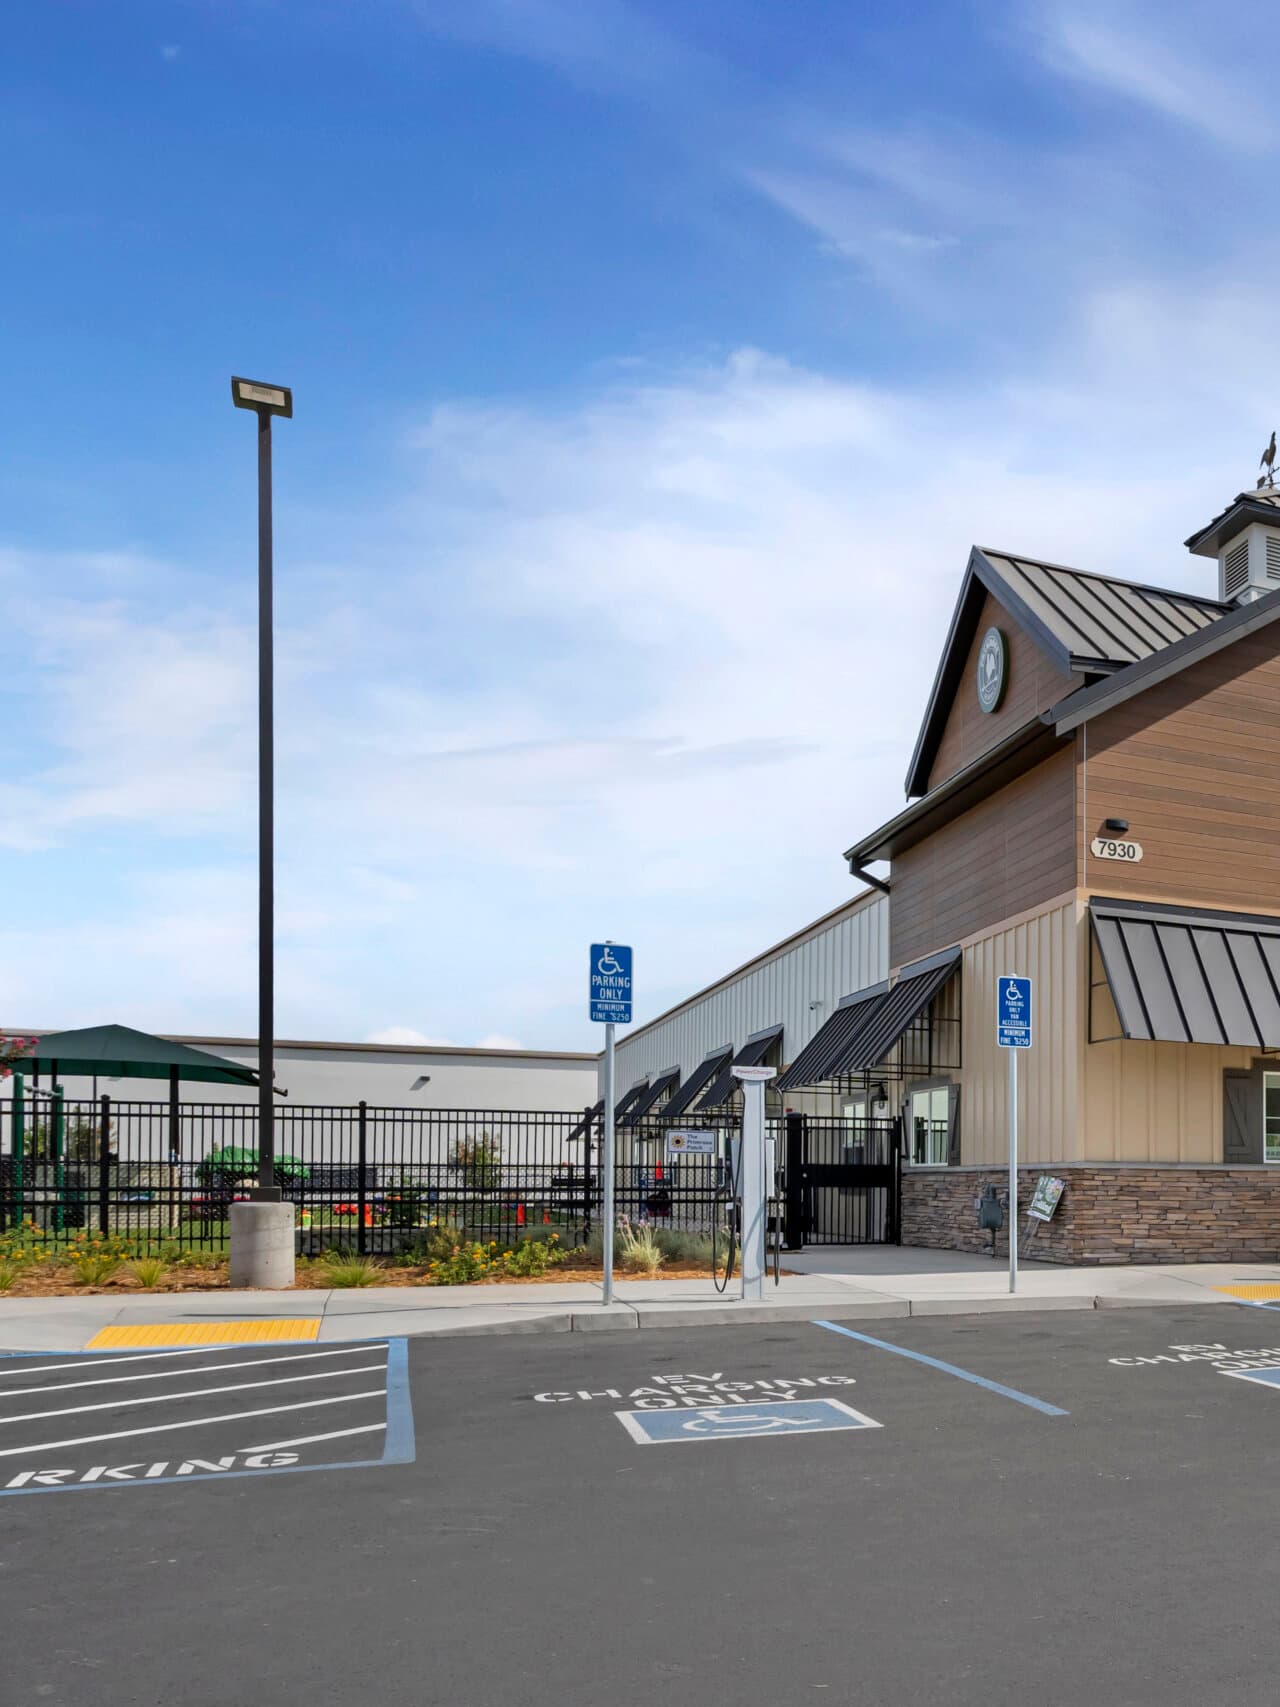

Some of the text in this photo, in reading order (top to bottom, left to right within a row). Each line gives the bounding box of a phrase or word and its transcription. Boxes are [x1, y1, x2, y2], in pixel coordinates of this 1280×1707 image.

[1098, 840, 1136, 859] 7930
[592, 975, 630, 988] PARKING
[600, 988, 623, 1000] ONLY
[597, 1003, 625, 1011] MINIMUM
[592, 1012, 606, 1020] FINE
[1004, 1029, 1025, 1037] MINIMUM
[1168, 1343, 1227, 1352] EV
[652, 1372, 722, 1385] EV
[534, 1376, 856, 1403] CHARGING
[634, 1389, 798, 1409] ONLY
[5, 1452, 300, 1489] RKING
